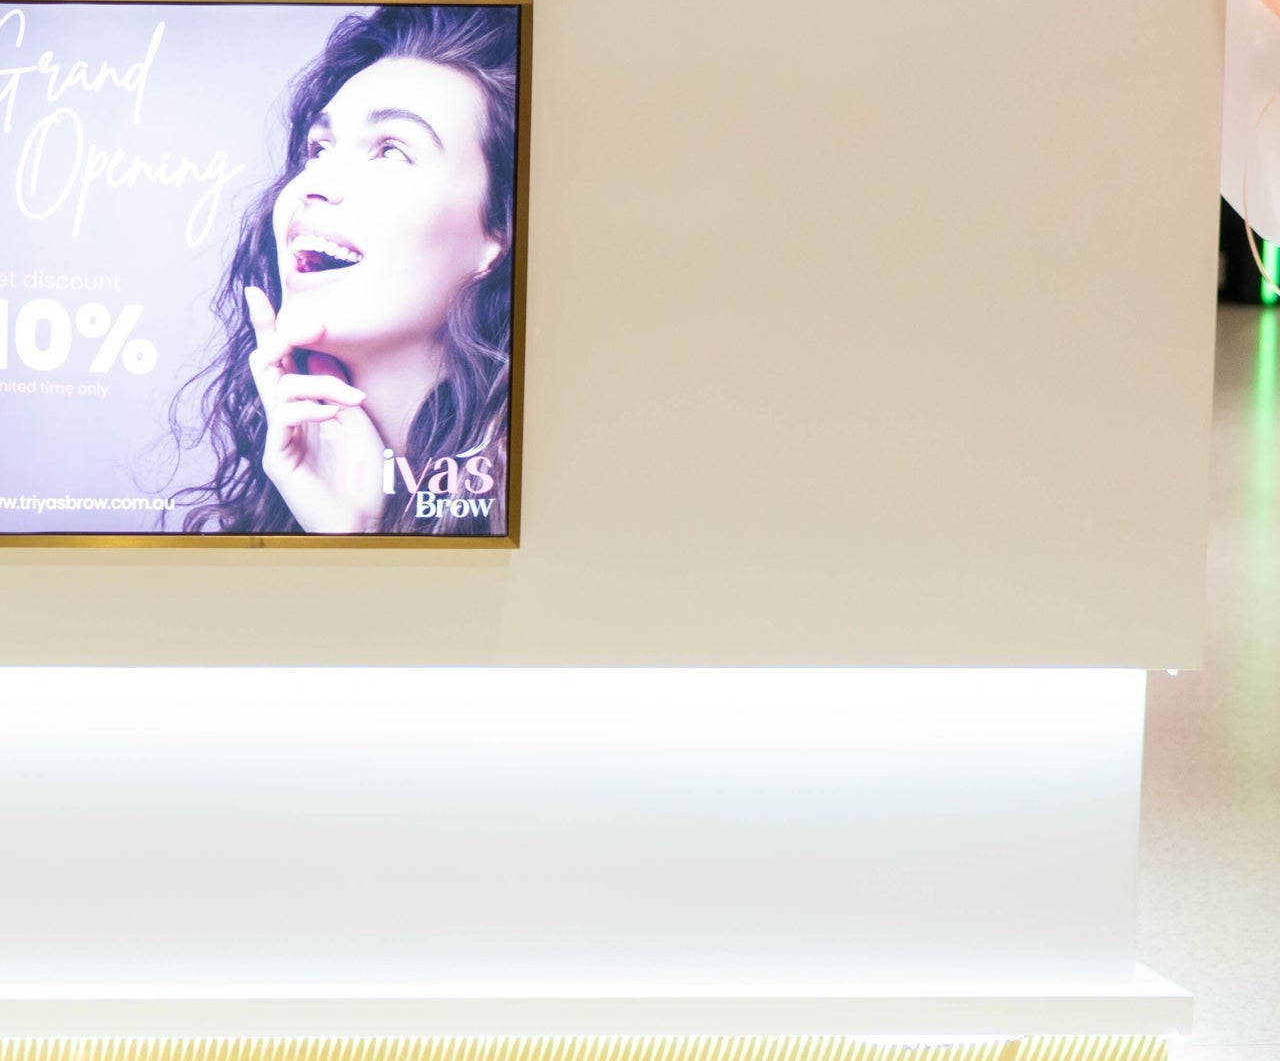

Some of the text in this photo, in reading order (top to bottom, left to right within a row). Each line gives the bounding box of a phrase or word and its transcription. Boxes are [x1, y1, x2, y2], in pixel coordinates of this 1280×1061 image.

[16, 107, 246, 248] Opening
[23, 270, 121, 291] discount
[40, 380, 74, 395] time
[77, 381, 110, 399] only
[415, 491, 496, 518] Brow
